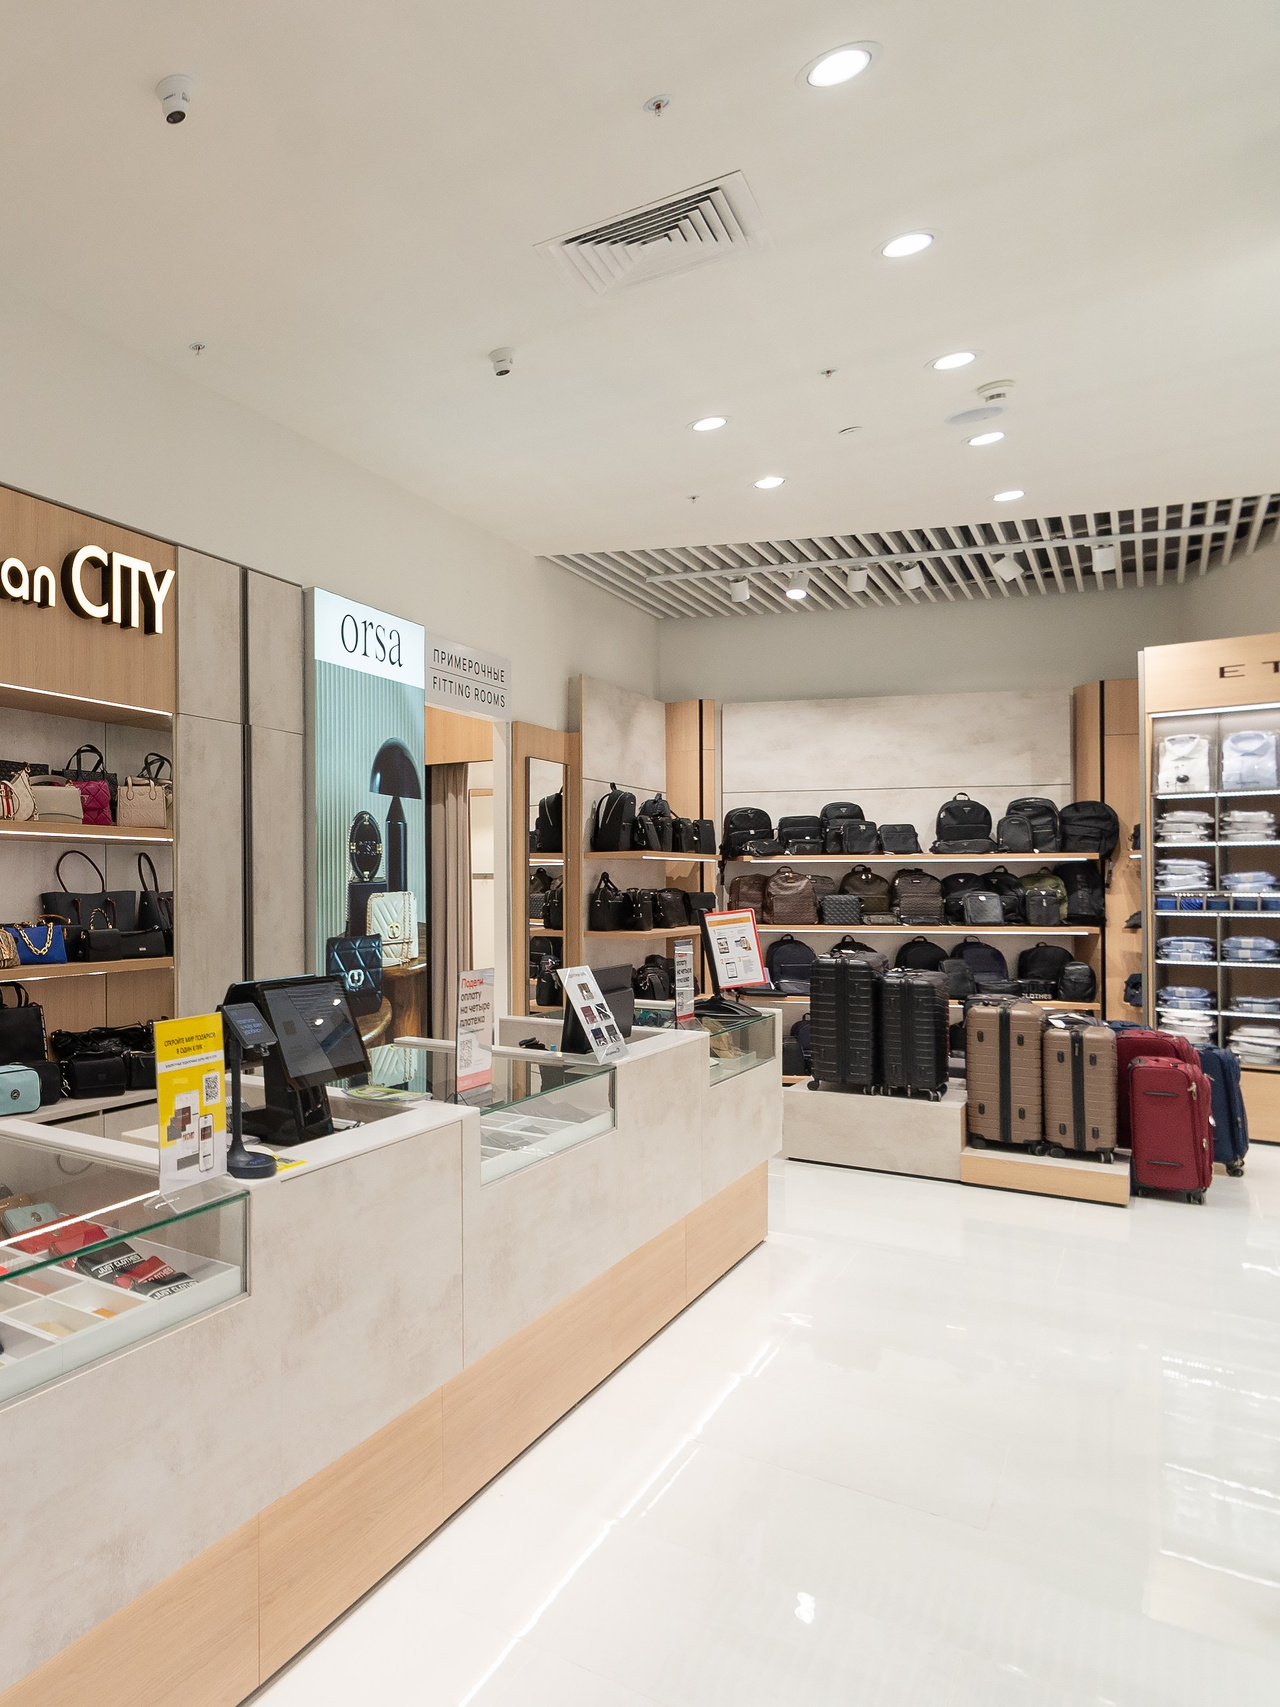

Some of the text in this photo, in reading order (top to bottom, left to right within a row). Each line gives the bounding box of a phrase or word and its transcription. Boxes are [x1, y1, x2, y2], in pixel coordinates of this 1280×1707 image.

[61, 544, 176, 636] CITY
[341, 614, 403, 668] orsa
[433, 648, 505, 683] ПРИМЕРОЧНЫЕ
[433, 676, 506, 708] FITTING ROOMS
[461, 978, 485, 990] Подели
[468, 1002, 490, 1014] четыре
[98, 1263, 114, 1274] JUST
[115, 1254, 140, 1267] CLOTHES
